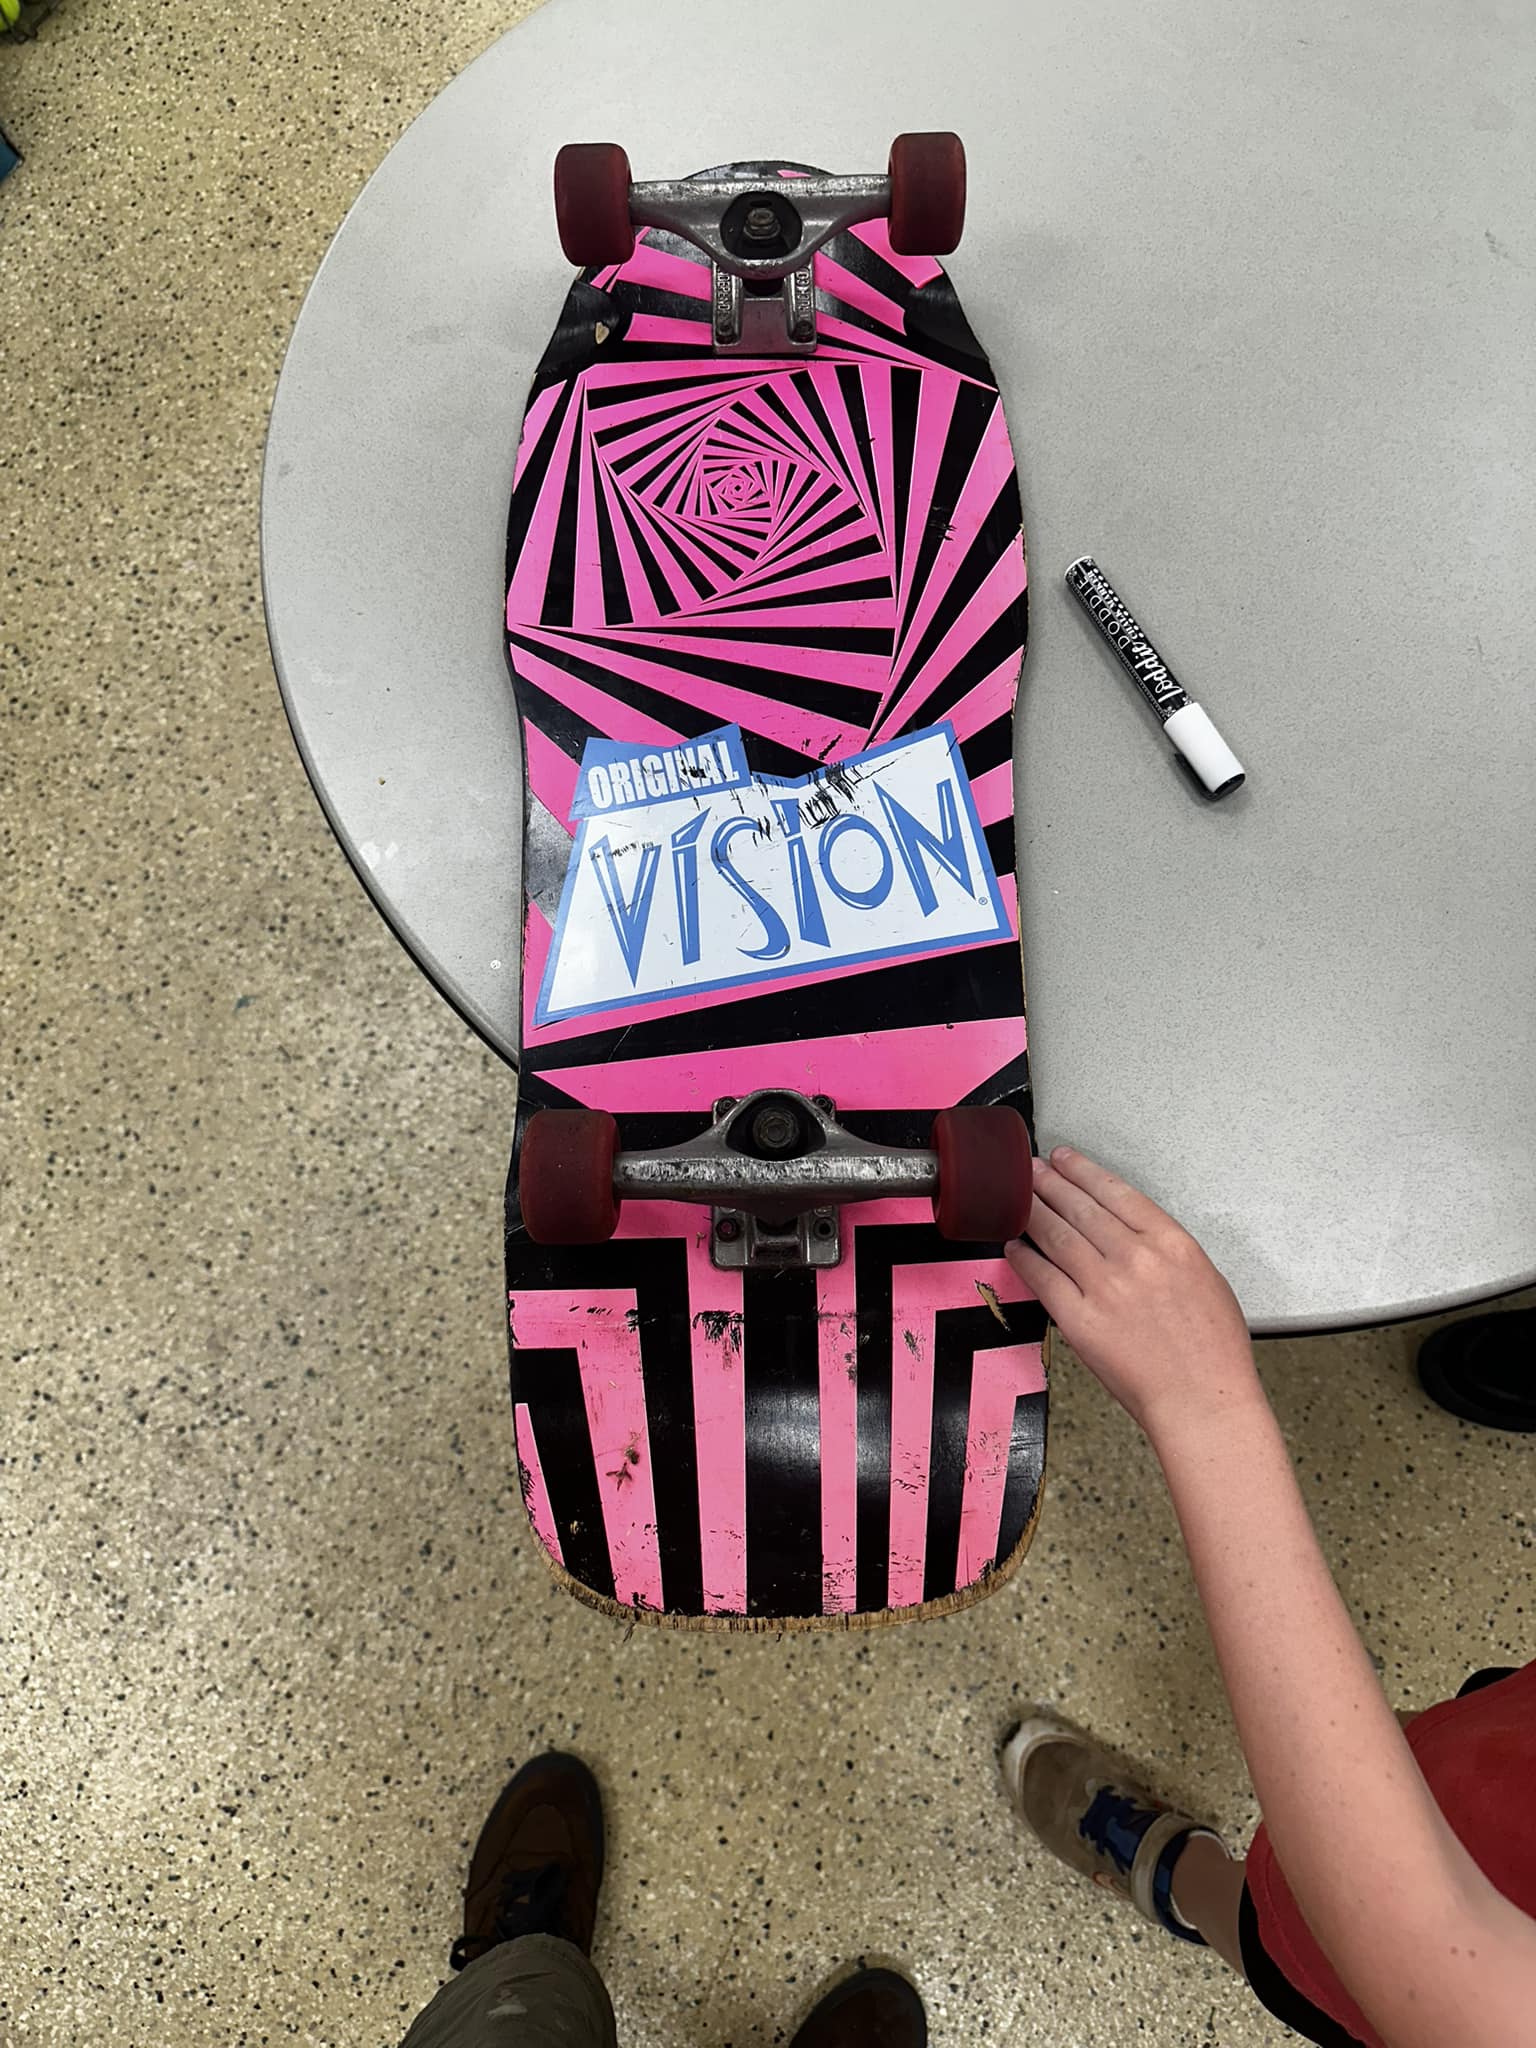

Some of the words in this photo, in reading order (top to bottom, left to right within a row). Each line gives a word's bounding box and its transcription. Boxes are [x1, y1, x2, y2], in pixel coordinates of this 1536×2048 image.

[1076, 574, 1130, 650] DODDIE
[1087, 570, 1117, 613] MARKER
[1113, 609, 1138, 641] CHALK
[587, 739, 739, 809] ORIGINAL
